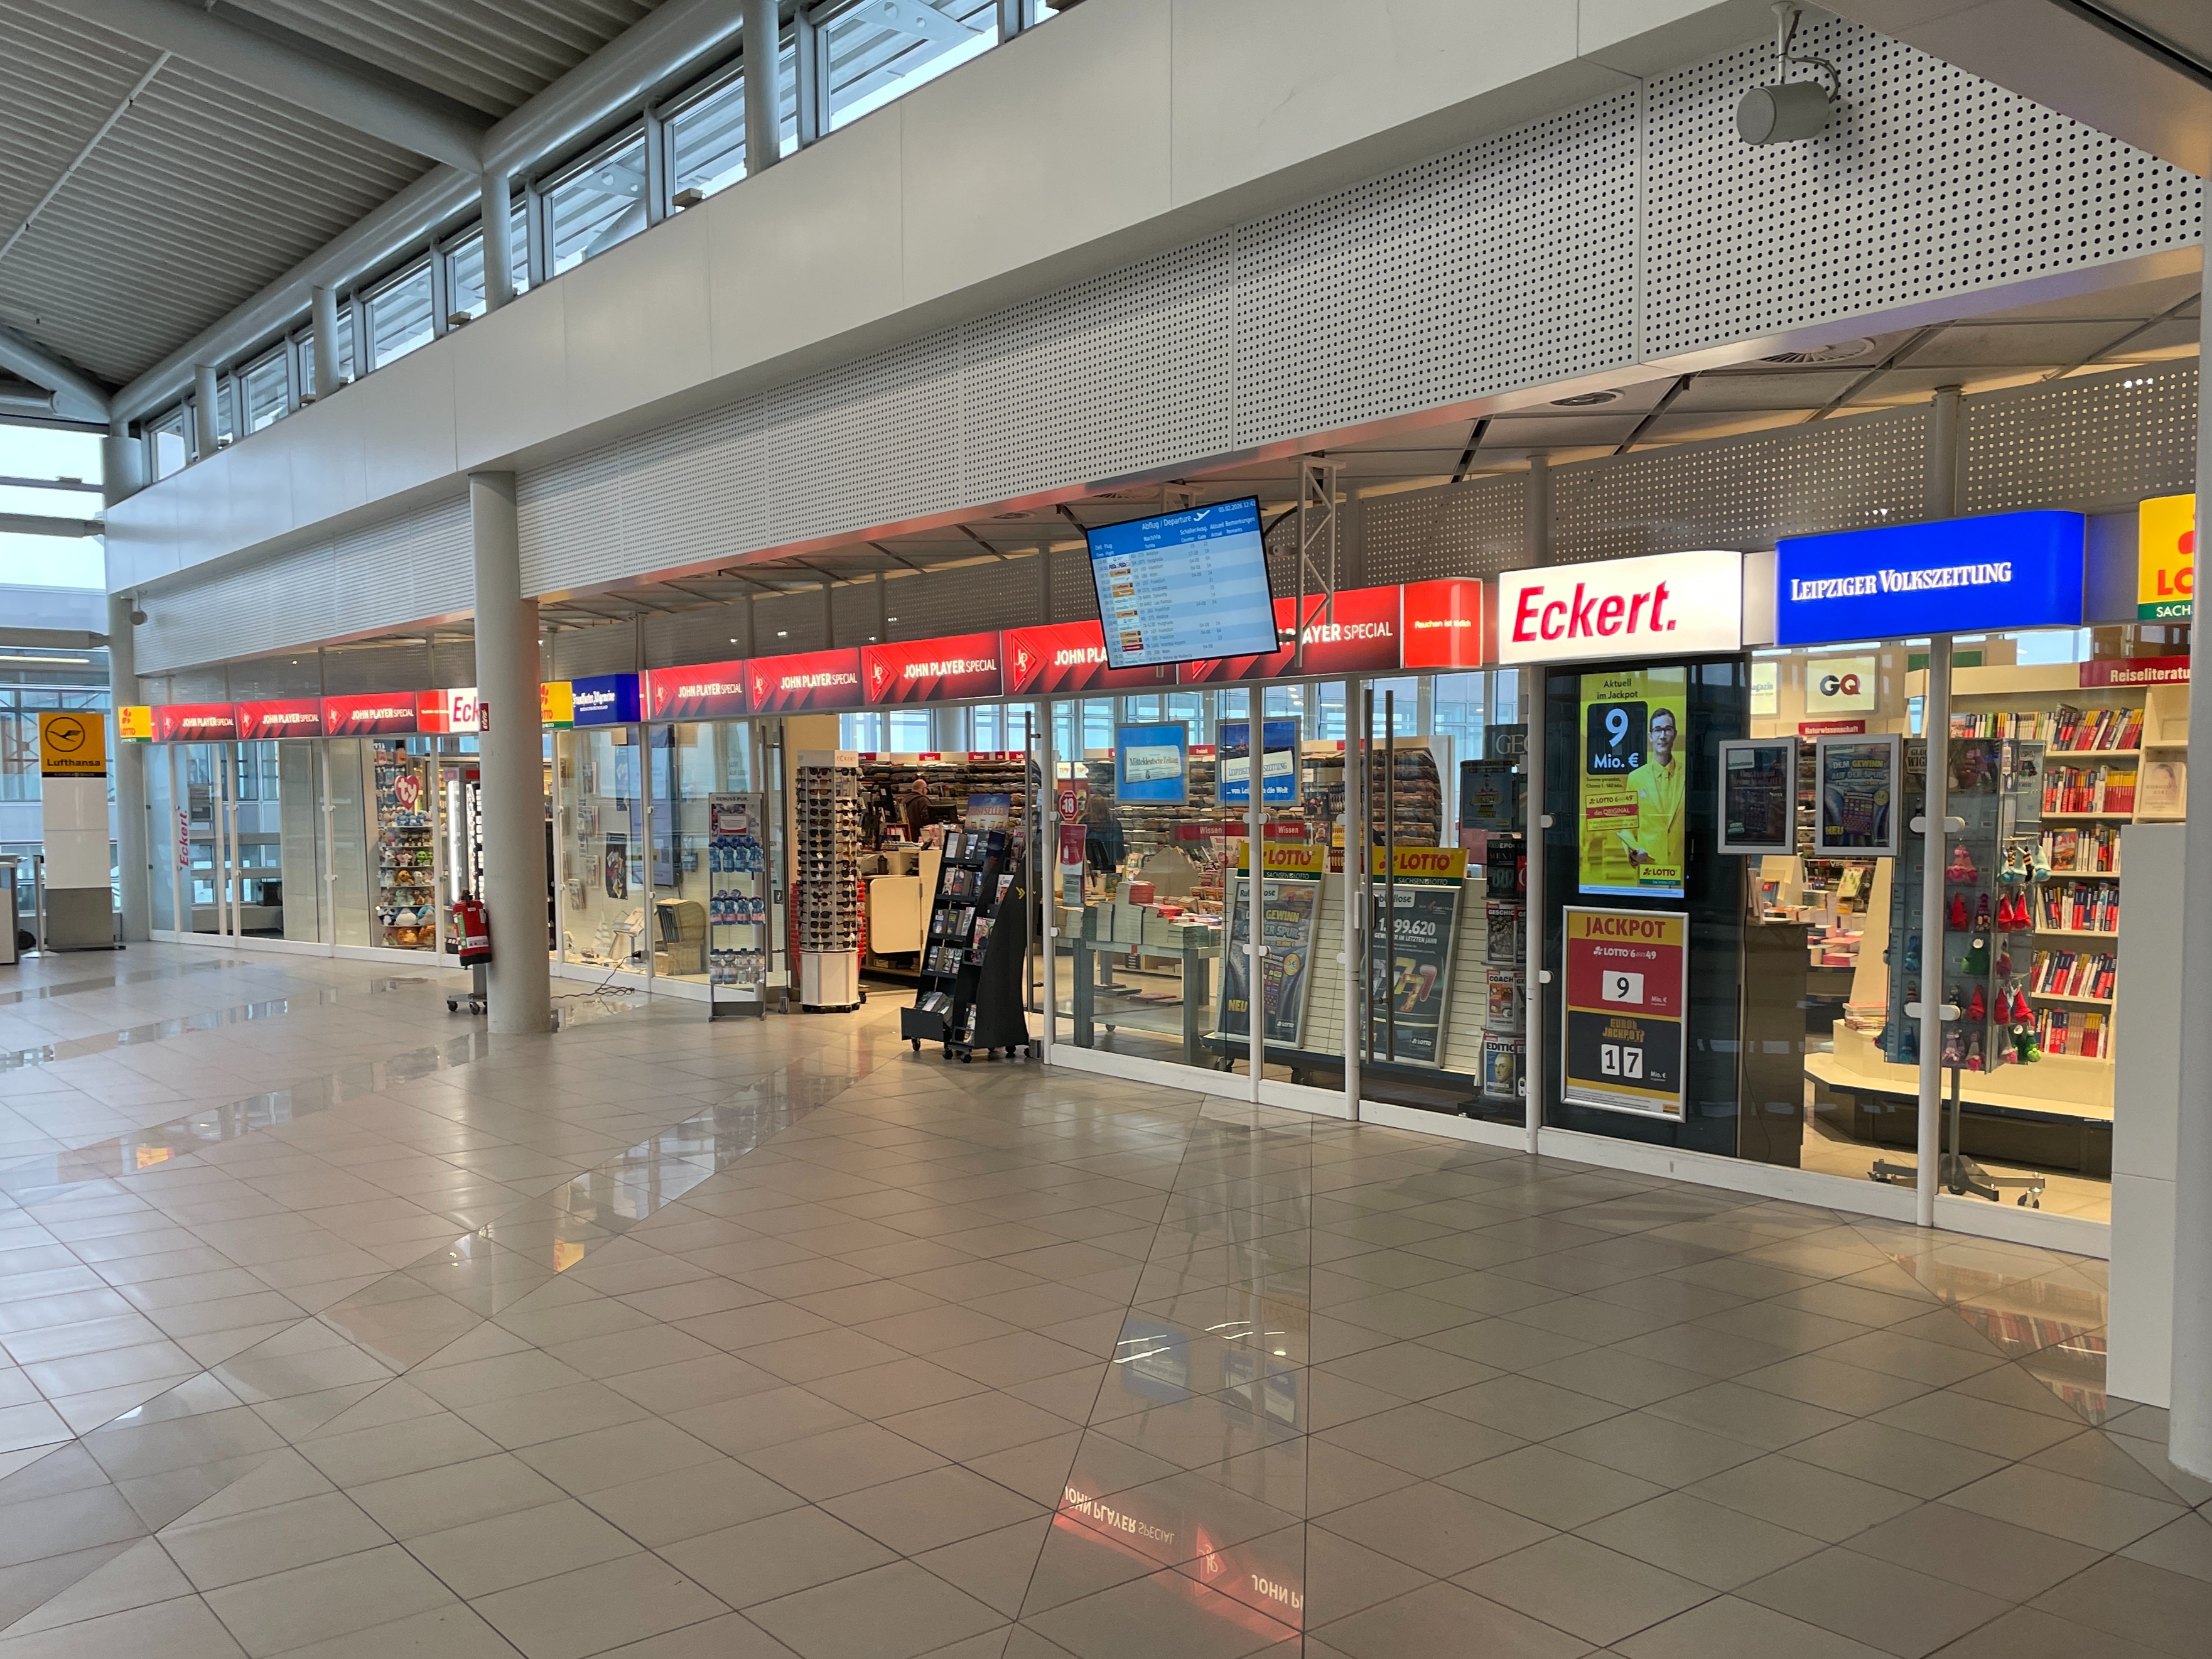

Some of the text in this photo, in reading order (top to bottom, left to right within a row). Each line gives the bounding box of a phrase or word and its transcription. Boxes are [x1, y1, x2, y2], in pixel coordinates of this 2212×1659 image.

[1141, 520, 1160, 532] Abflug
[1162, 514, 1192, 528] Departure
[1791, 561, 2012, 601] LEIPZIGER VOLKSZEITUNG
[1512, 580, 1677, 642] Eckert.
[2156, 605, 2191, 618] SACH
[1302, 621, 1393, 643] AYER SPECIAL
[1054, 647, 1108, 666] JOHN PLA
[904, 659, 996, 679] JOHN PLAYER SPECIAL
[2110, 666, 2190, 683] Reiseliteratu
[780, 673, 858, 689] JOHN PLAYER SPECIAL
[1604, 678, 1632, 689] Aktuell
[1751, 682, 1774, 692] agazin
[1820, 674, 1861, 696] GQ
[678, 683, 742, 698] JOHN PLAYER SPECIAL
[1597, 690, 1638, 701] im Jackpot
[262, 715, 278, 724] JOHN
[279, 713, 299, 723] PLAYER
[352, 710, 369, 720] JOHN
[370, 708, 393, 720] PLAYER
[393, 708, 414, 718] SPECIAL
[1605, 708, 1629, 748] 9
[1805, 725, 1859, 734] Naturwissenschaft
[46, 758, 100, 767] Lufthansa
[1594, 752, 1639, 769] Mio. €
[1833, 760, 1884, 769] DEM GEWINN
[397, 777, 419, 802] ty
[1278, 825, 1299, 834] Wissen
[1825, 826, 1844, 836] NEU
[1268, 850, 1312, 866] LOTTO
[1400, 853, 1450, 871] LOTTO
[1653, 868, 1676, 877] LOTTO
[1266, 909, 1300, 923] GEWINN
[1585, 917, 1666, 938] JACKPOT
[1604, 947, 1629, 957] LOTTO
[1630, 949, 1636, 958] 6
[1646, 950, 1657, 959] 49
[1489, 975, 1514, 983] COACH
[1617, 977, 1629, 998] 9
[1228, 999, 1248, 1013] NEU
[1486, 1042, 1514, 1052] EDITIO
